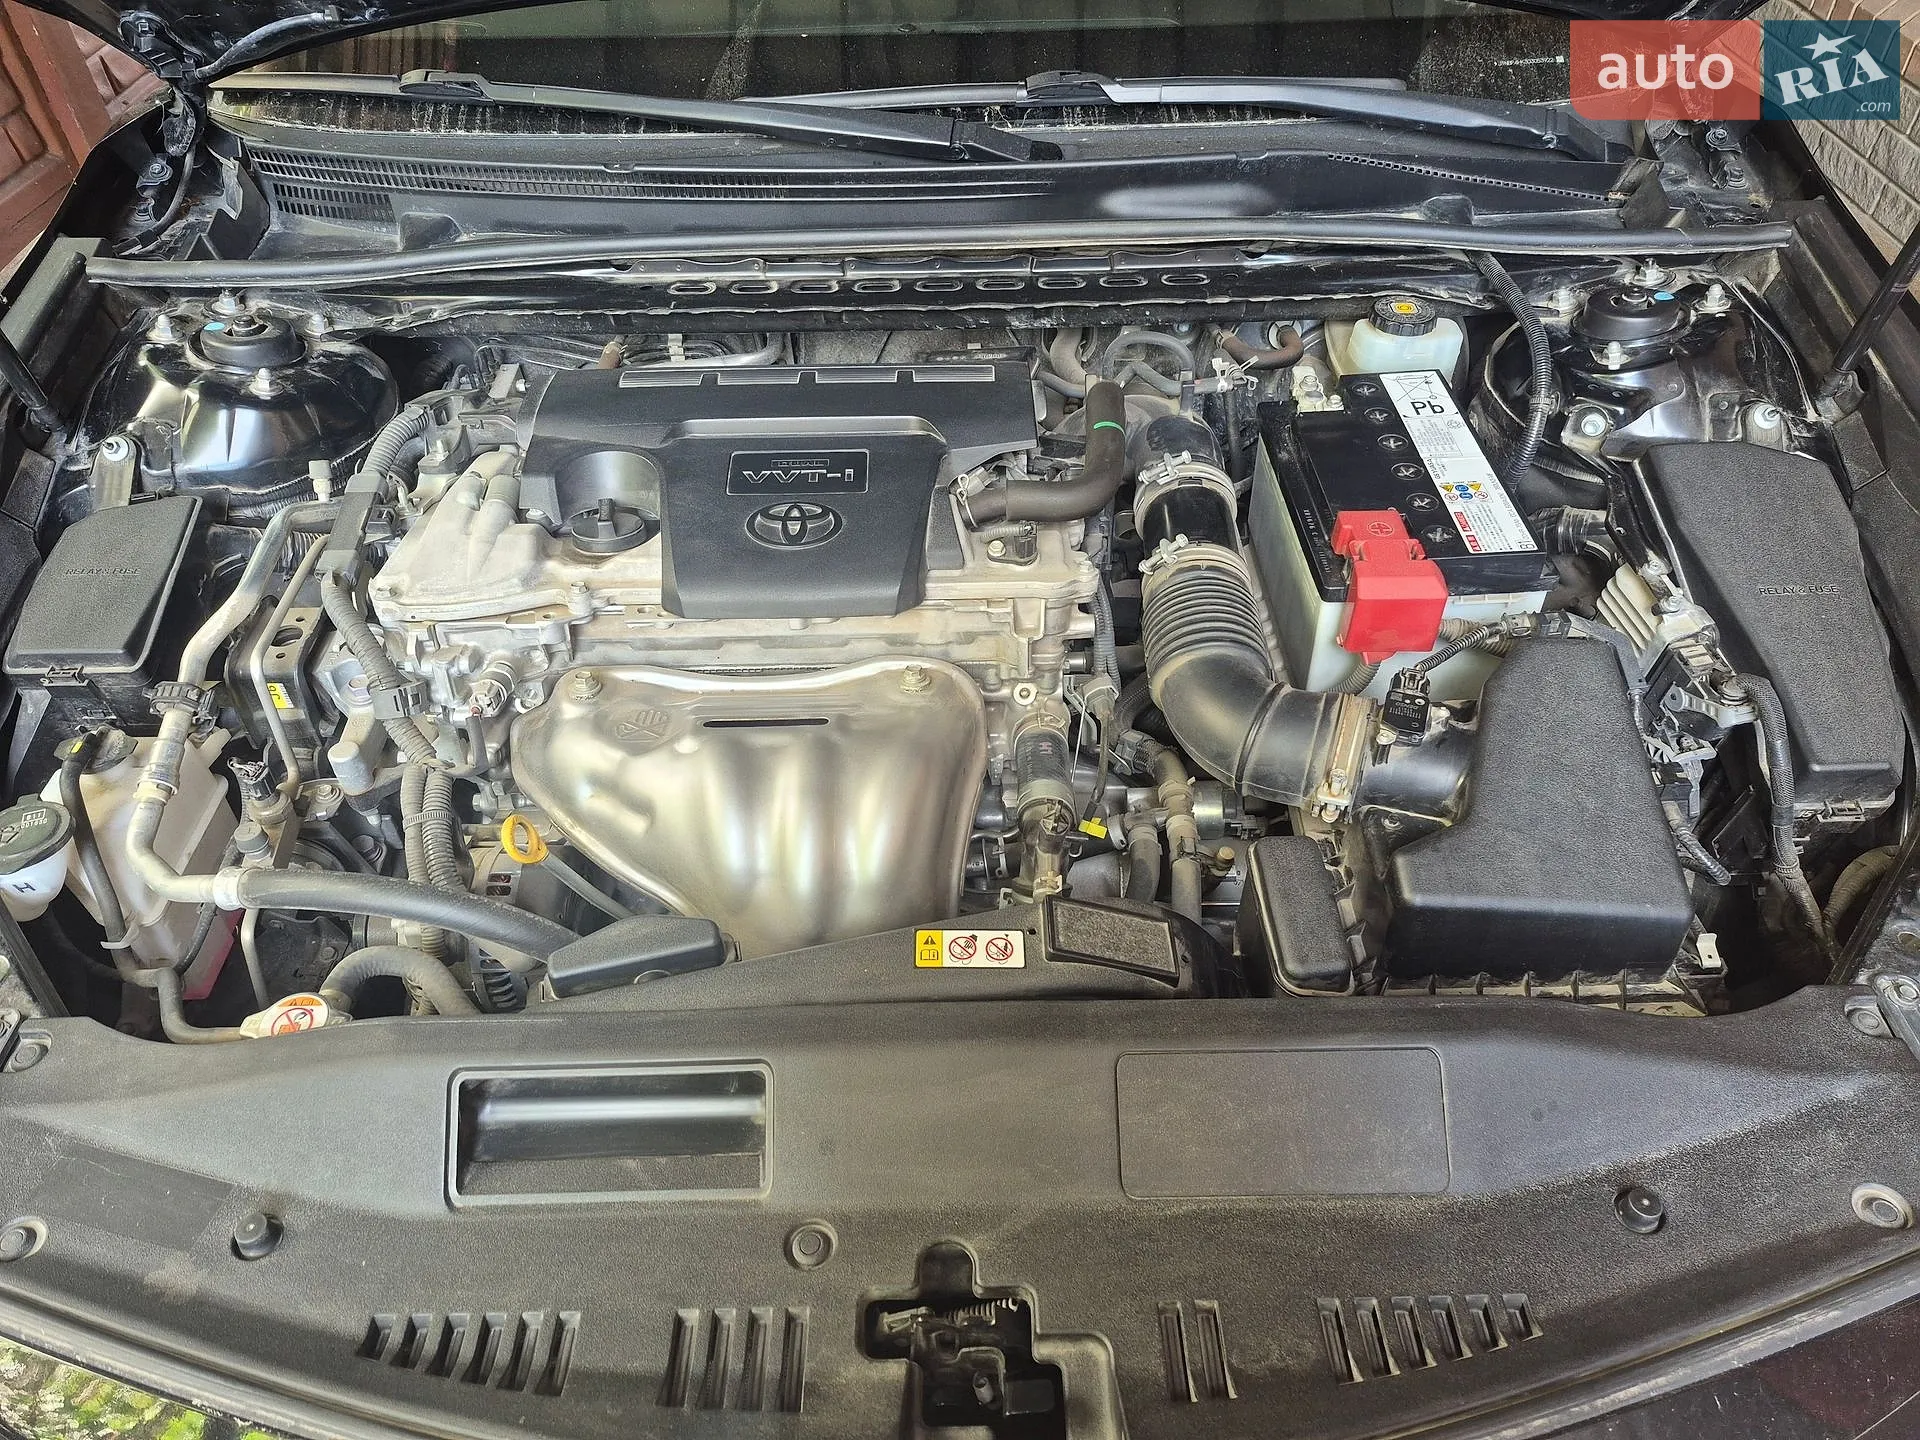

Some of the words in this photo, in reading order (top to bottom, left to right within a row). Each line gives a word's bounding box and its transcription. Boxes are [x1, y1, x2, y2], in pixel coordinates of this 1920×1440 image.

[1410, 401, 1445, 416] Pb
[742, 469, 854, 483] VVT-i
[1759, 585, 1796, 595] RELAY
[1808, 584, 1840, 594] FUSE
